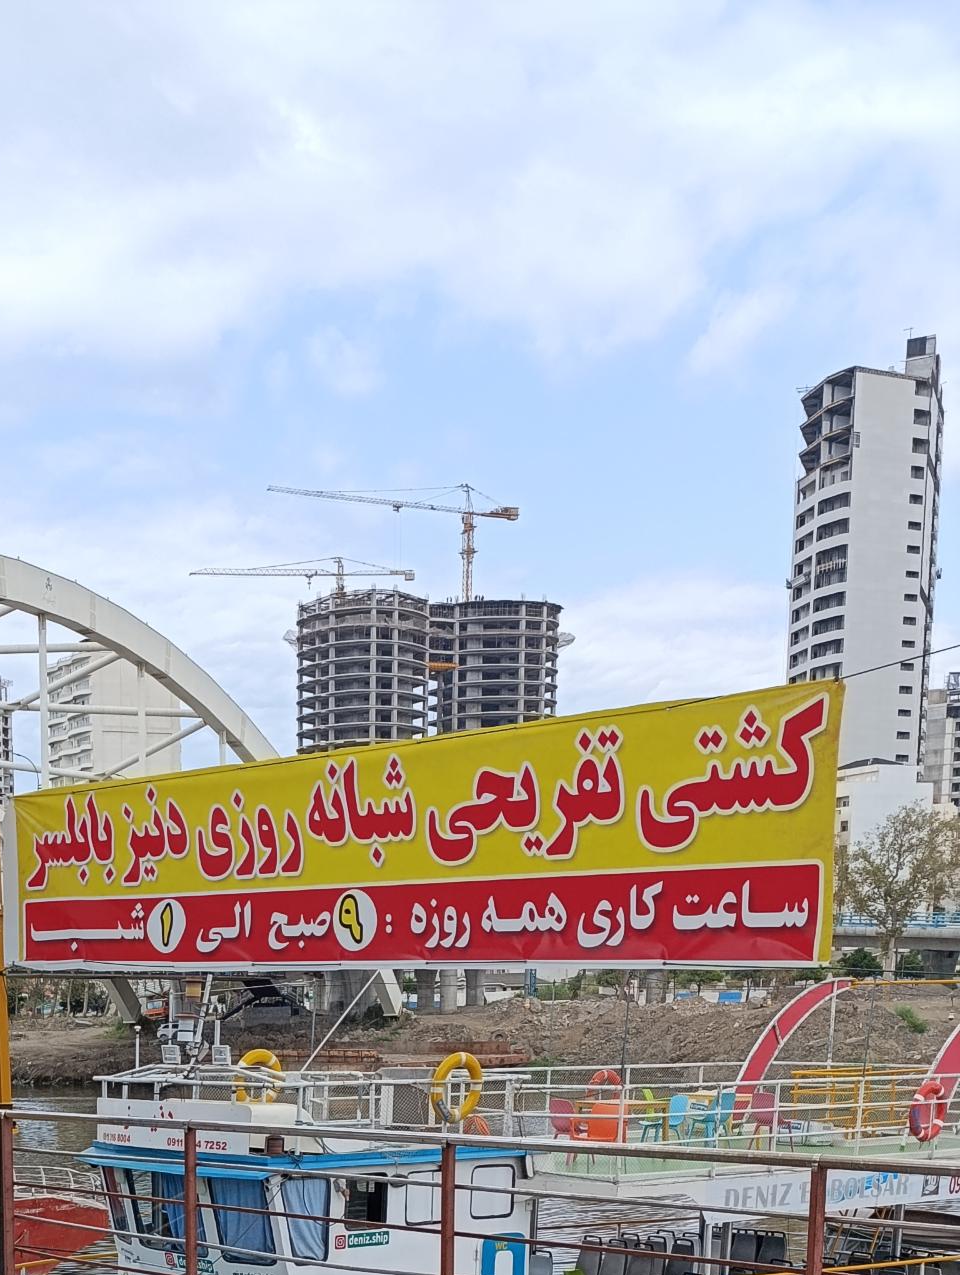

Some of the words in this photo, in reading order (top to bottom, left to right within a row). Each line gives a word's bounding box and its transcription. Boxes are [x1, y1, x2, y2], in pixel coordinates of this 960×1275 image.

[426, 724, 624, 866] تفریحی
[637, 692, 830, 853] کشتی
[122, 785, 190, 887] دنیز
[196, 789, 304, 881] روزی
[306, 754, 416, 867] شبانه
[26, 792, 116, 890] بابلسر
[30, 903, 145, 951] شب
[196, 901, 253, 953] الی
[268, 910, 332, 950] صبح
[338, 893, 364, 945] ۹
[410, 898, 471, 949] روزه
[481, 892, 568, 933] همه
[576, 880, 664, 948] کاری
[672, 880, 809, 931] ساعت
[204, 1140, 228, 1150] 7252
[348, 1232, 389, 1246] deniz.ship
[495, 1241, 508, 1250] WC
